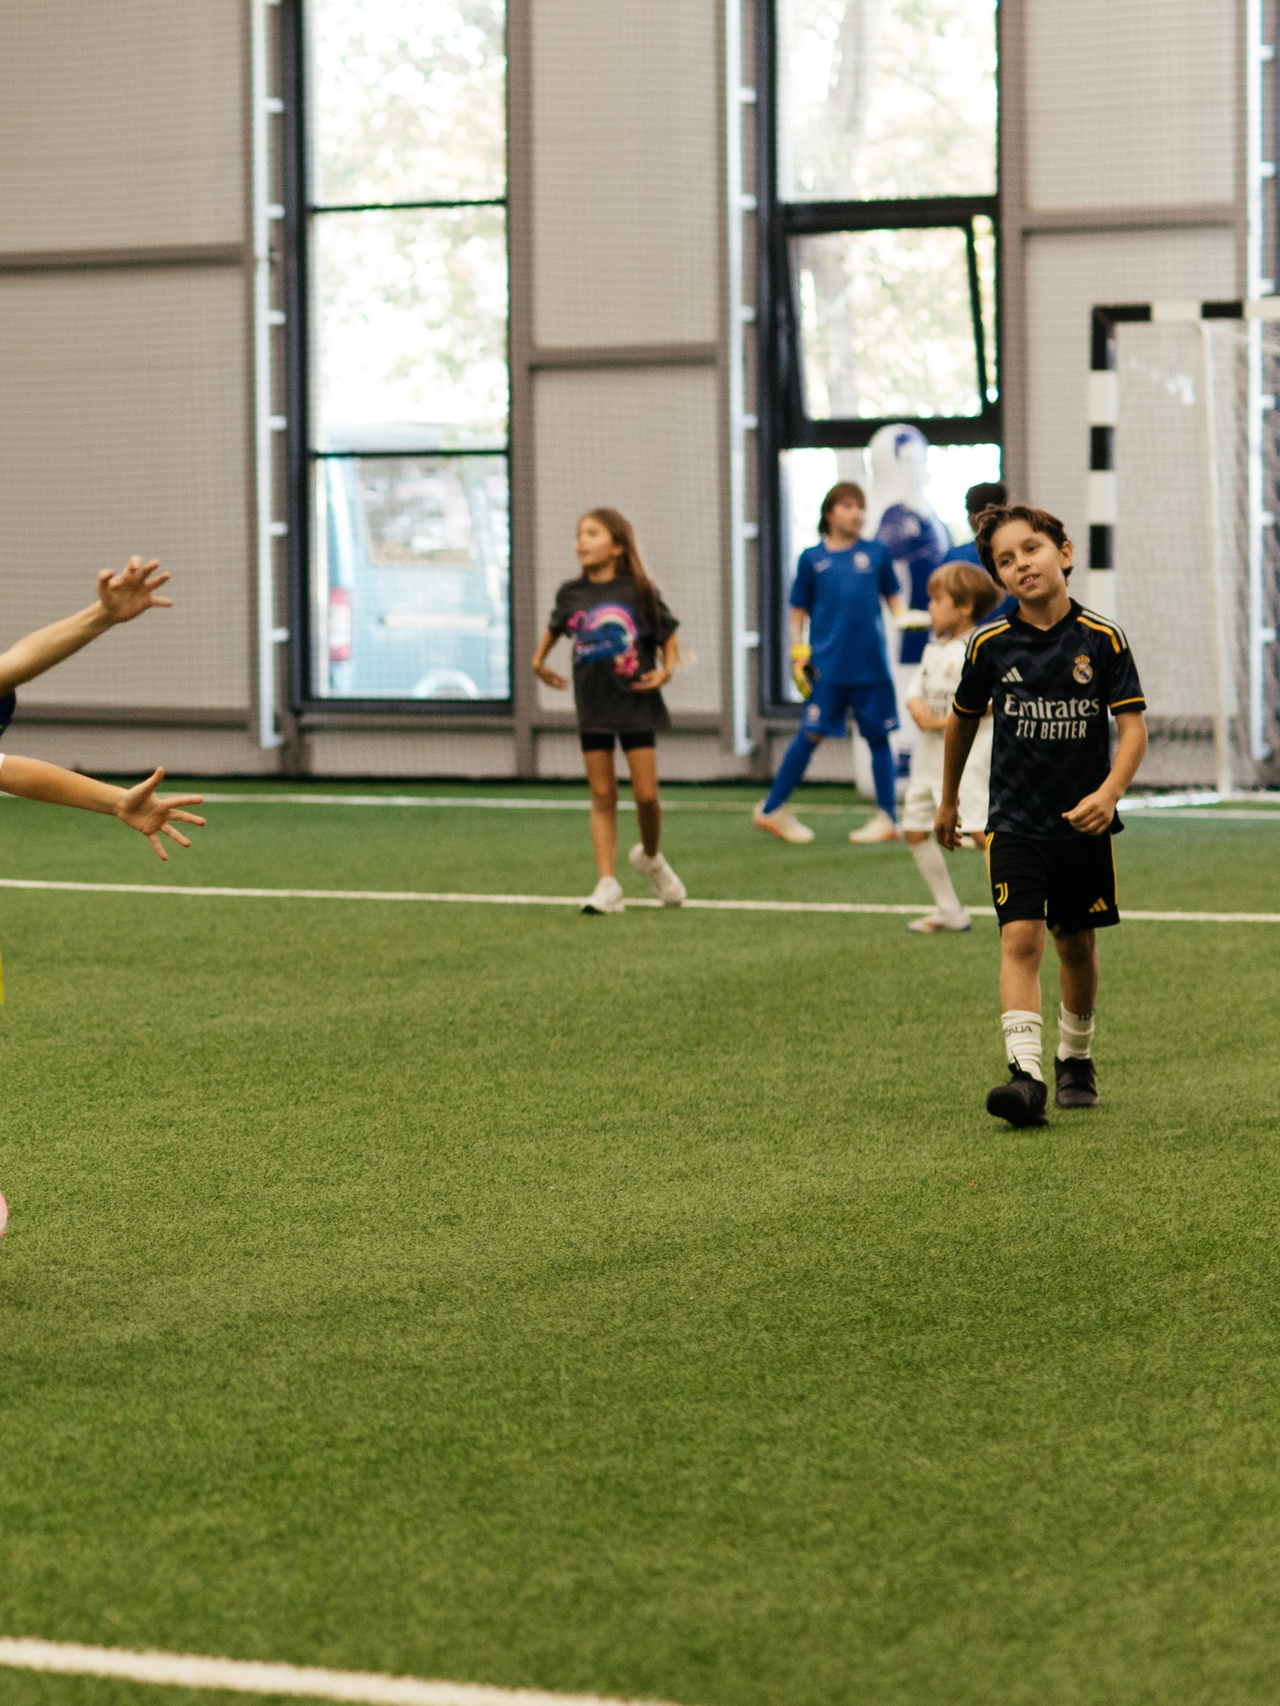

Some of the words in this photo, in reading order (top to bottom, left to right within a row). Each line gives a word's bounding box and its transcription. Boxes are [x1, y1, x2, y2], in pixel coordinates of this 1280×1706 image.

[1004, 693, 1099, 719] Emirates
[1016, 720, 1037, 739] FLY
[1040, 720, 1087, 739] BETTER
